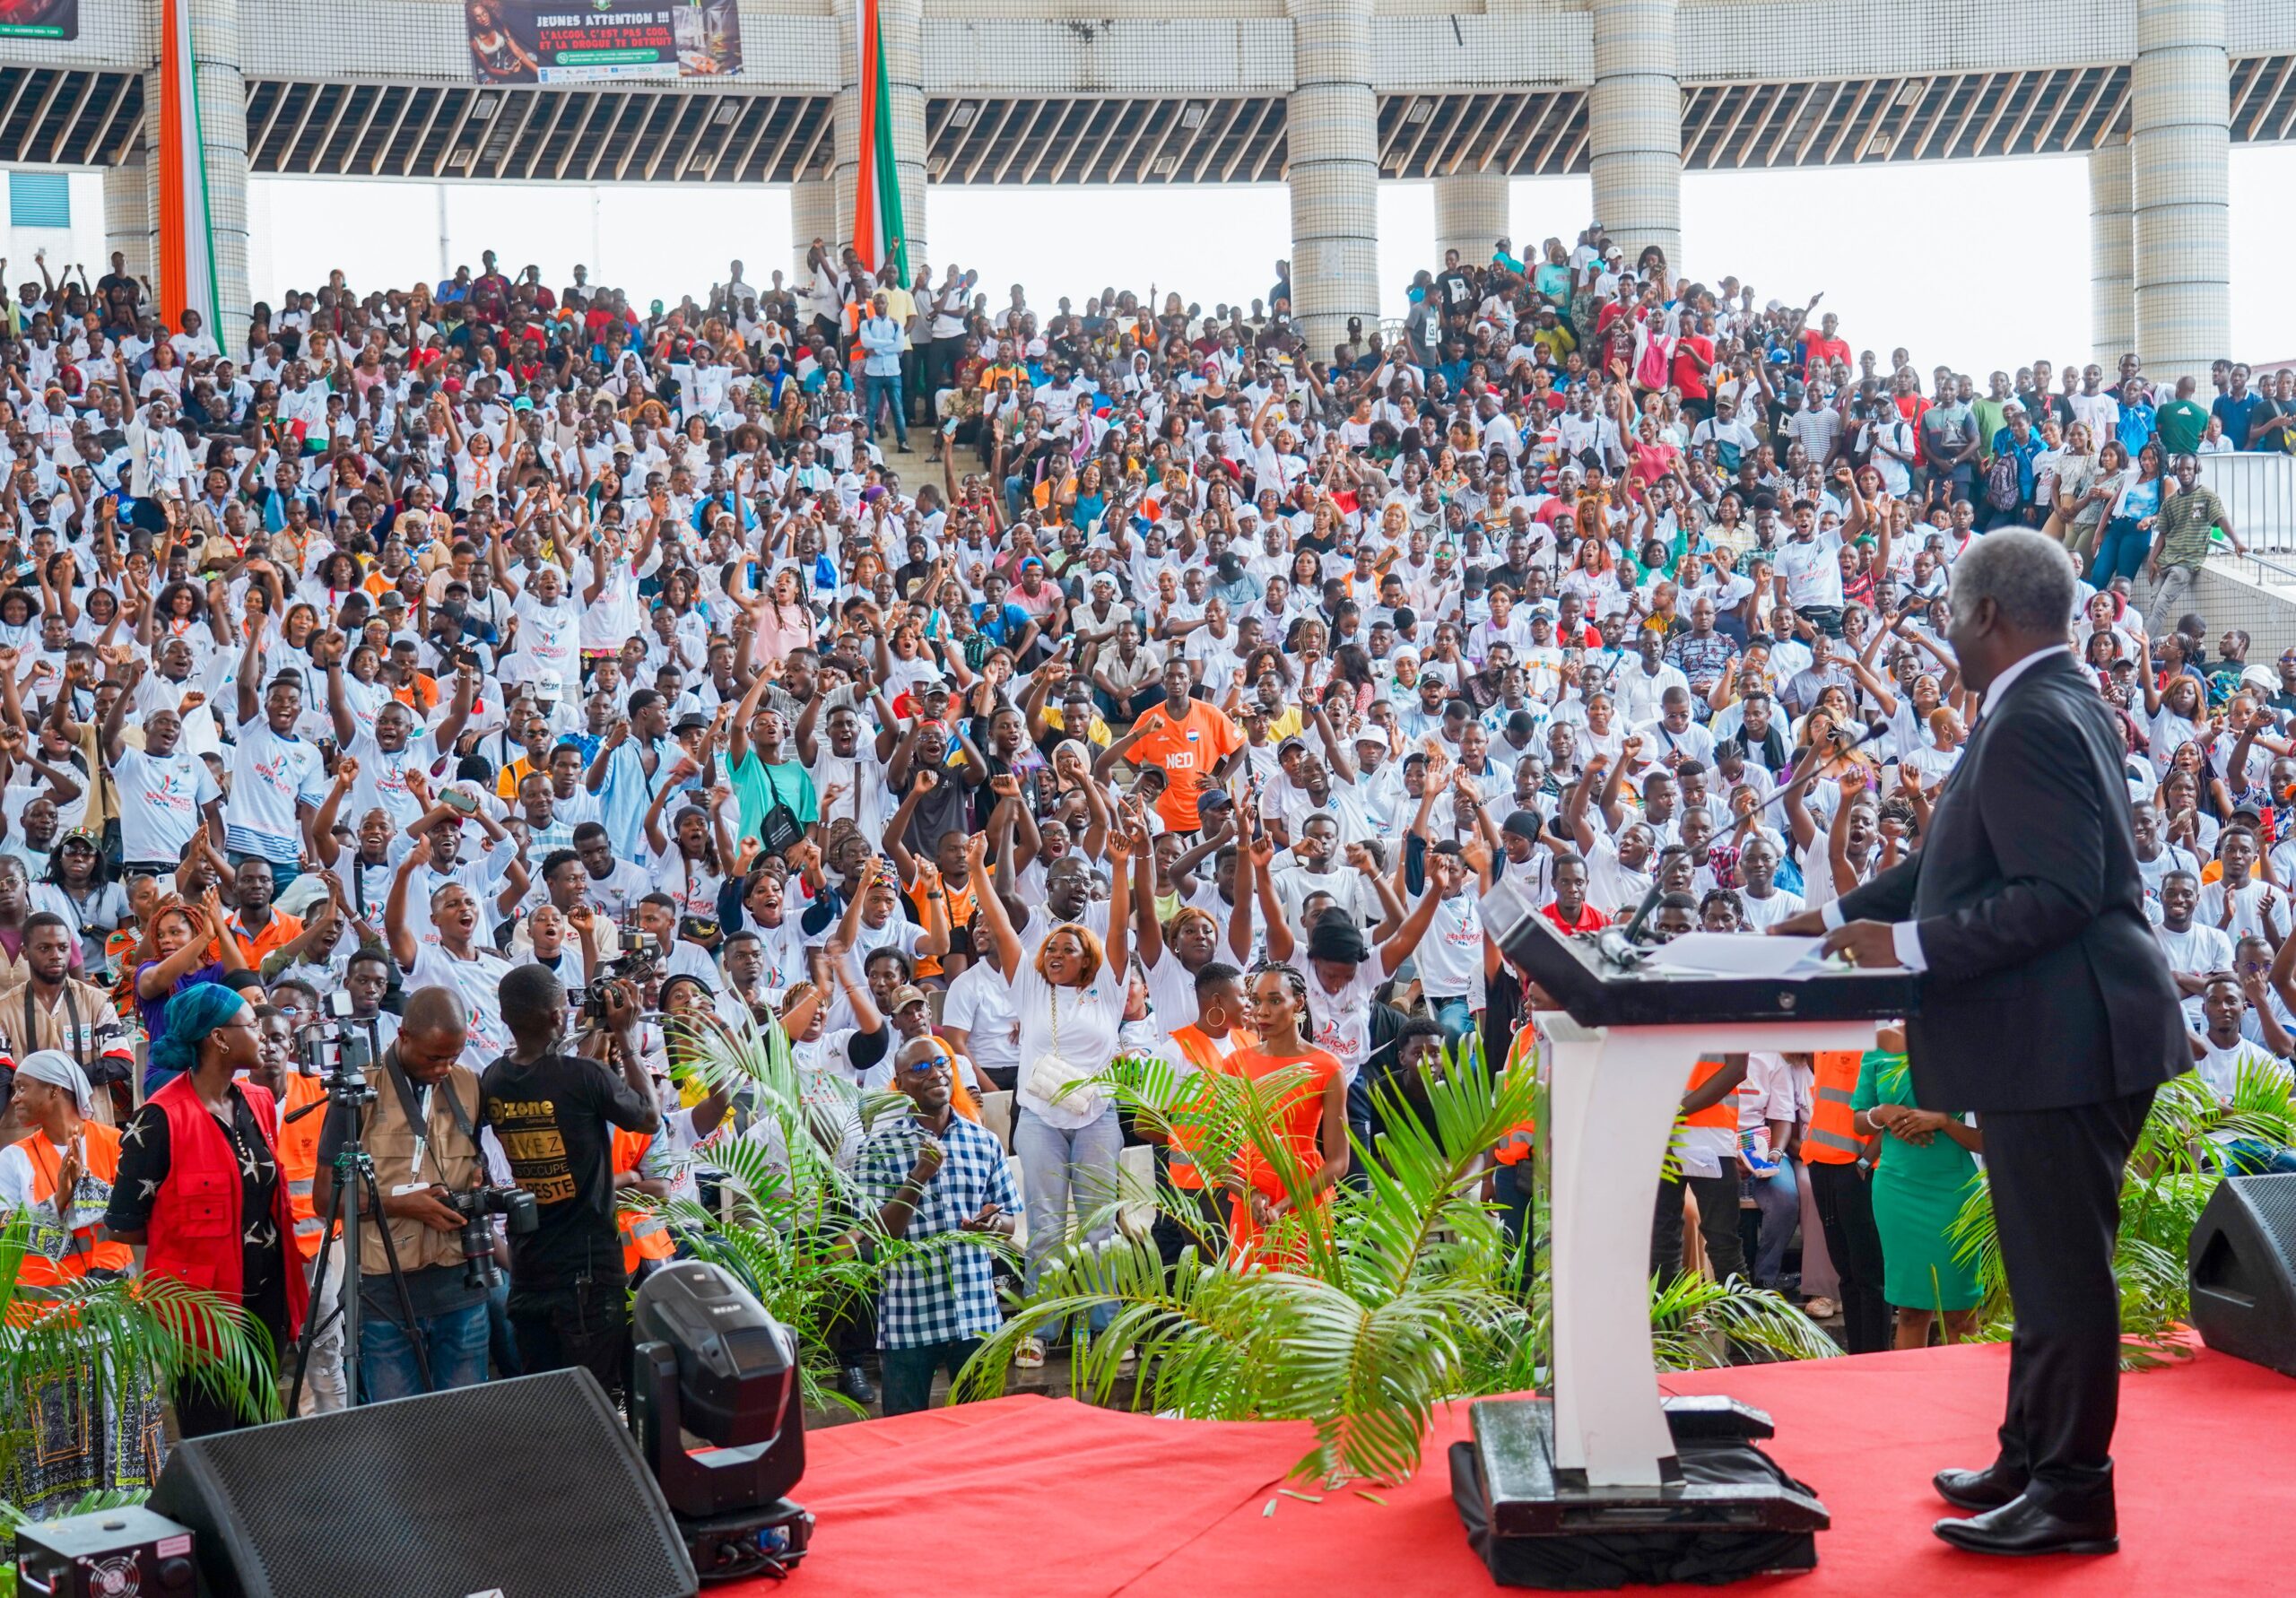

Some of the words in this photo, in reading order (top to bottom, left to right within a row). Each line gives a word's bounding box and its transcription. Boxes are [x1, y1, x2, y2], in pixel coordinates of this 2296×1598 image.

[536, 15, 581, 27] JEUNES
[586, 13, 652, 26] ATTENTION
[540, 30, 587, 39] L'ALCOOL
[590, 29, 618, 39] C'EST
[622, 28, 641, 37] PAS
[646, 27, 669, 36] COOL
[540, 41, 552, 50] ET
[556, 40, 568, 49] LA
[572, 39, 611, 48] DROGUE
[615, 39, 627, 47] TE
[631, 37, 672, 47] DETRUIT
[1166, 751, 1194, 769] NED
